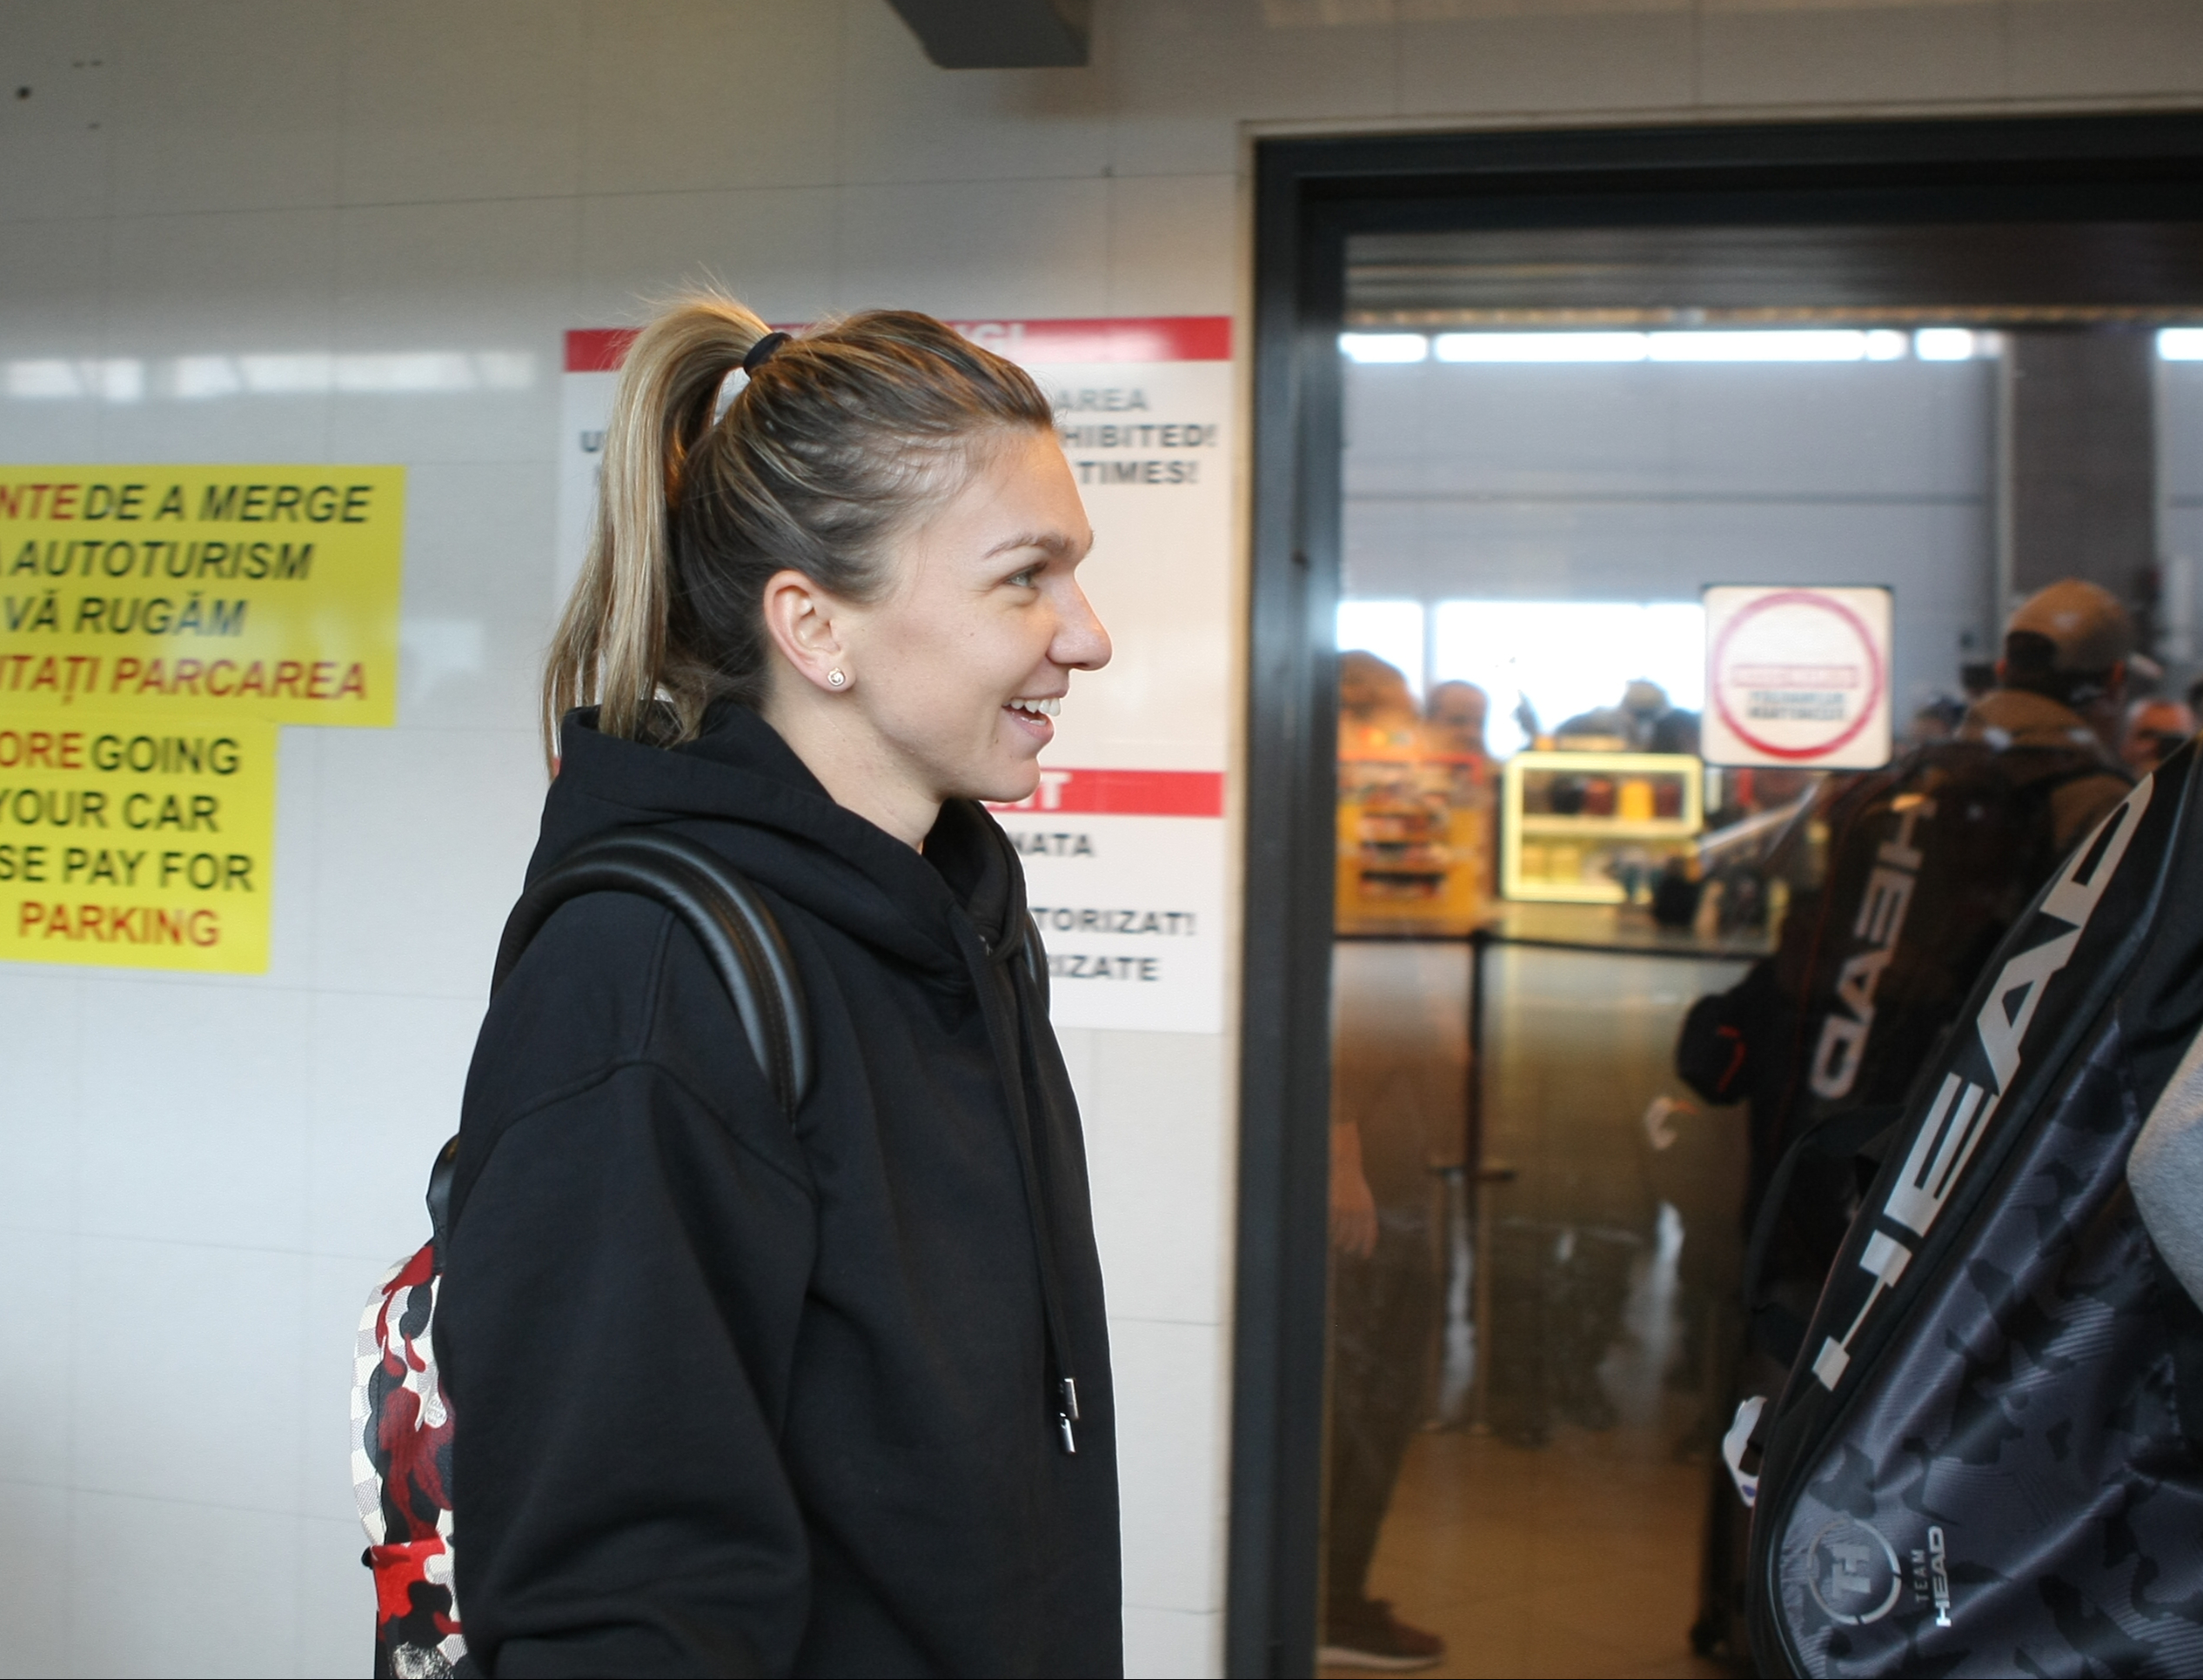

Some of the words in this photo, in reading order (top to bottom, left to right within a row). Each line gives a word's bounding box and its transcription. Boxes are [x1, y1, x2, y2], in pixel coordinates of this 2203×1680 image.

[1077, 460, 1199, 484] TIMES!
[82, 484, 146, 522] DE
[155, 485, 186, 521] A
[198, 485, 373, 524] MERGE
[9, 540, 314, 580] AUTOTURISM
[74, 591, 247, 637] RUGĂM
[111, 658, 368, 700] PARCAREA
[91, 734, 241, 775] GOING
[123, 793, 221, 833] CAR
[63, 847, 147, 887] PAY
[158, 851, 254, 893] FOR
[17, 900, 220, 947] PARKING
[1028, 907, 1197, 936] TORIZAT!
[1812, 772, 2153, 1391] HEAD
[1911, 1549, 1930, 1603] TEAM
[1928, 1526, 1952, 1627] HEAD
